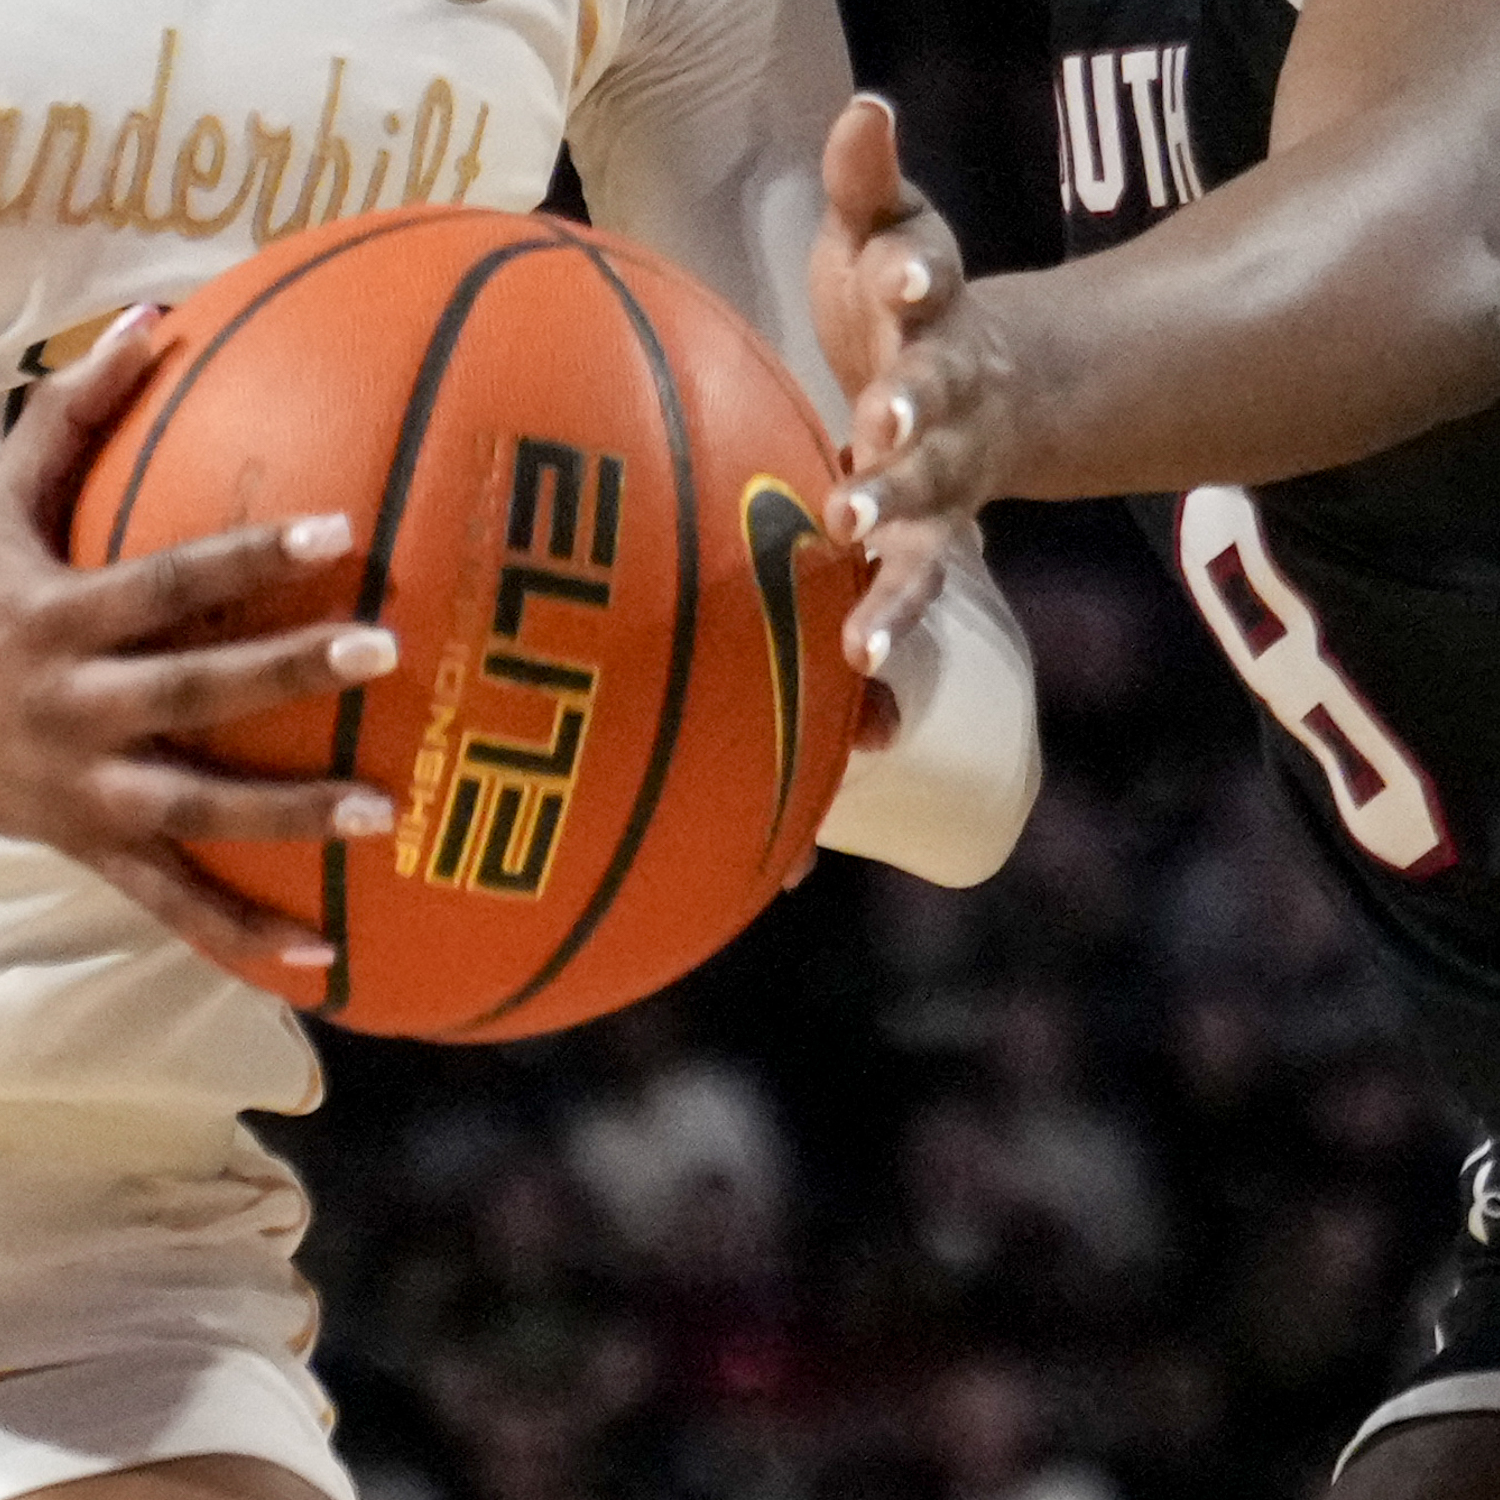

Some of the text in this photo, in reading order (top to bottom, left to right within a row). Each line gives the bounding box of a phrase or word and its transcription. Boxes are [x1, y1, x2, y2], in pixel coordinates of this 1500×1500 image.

[1053, 44, 1203, 214] UTH
[424, 434, 626, 900] ELITE
[1174, 483, 1458, 881] 8
